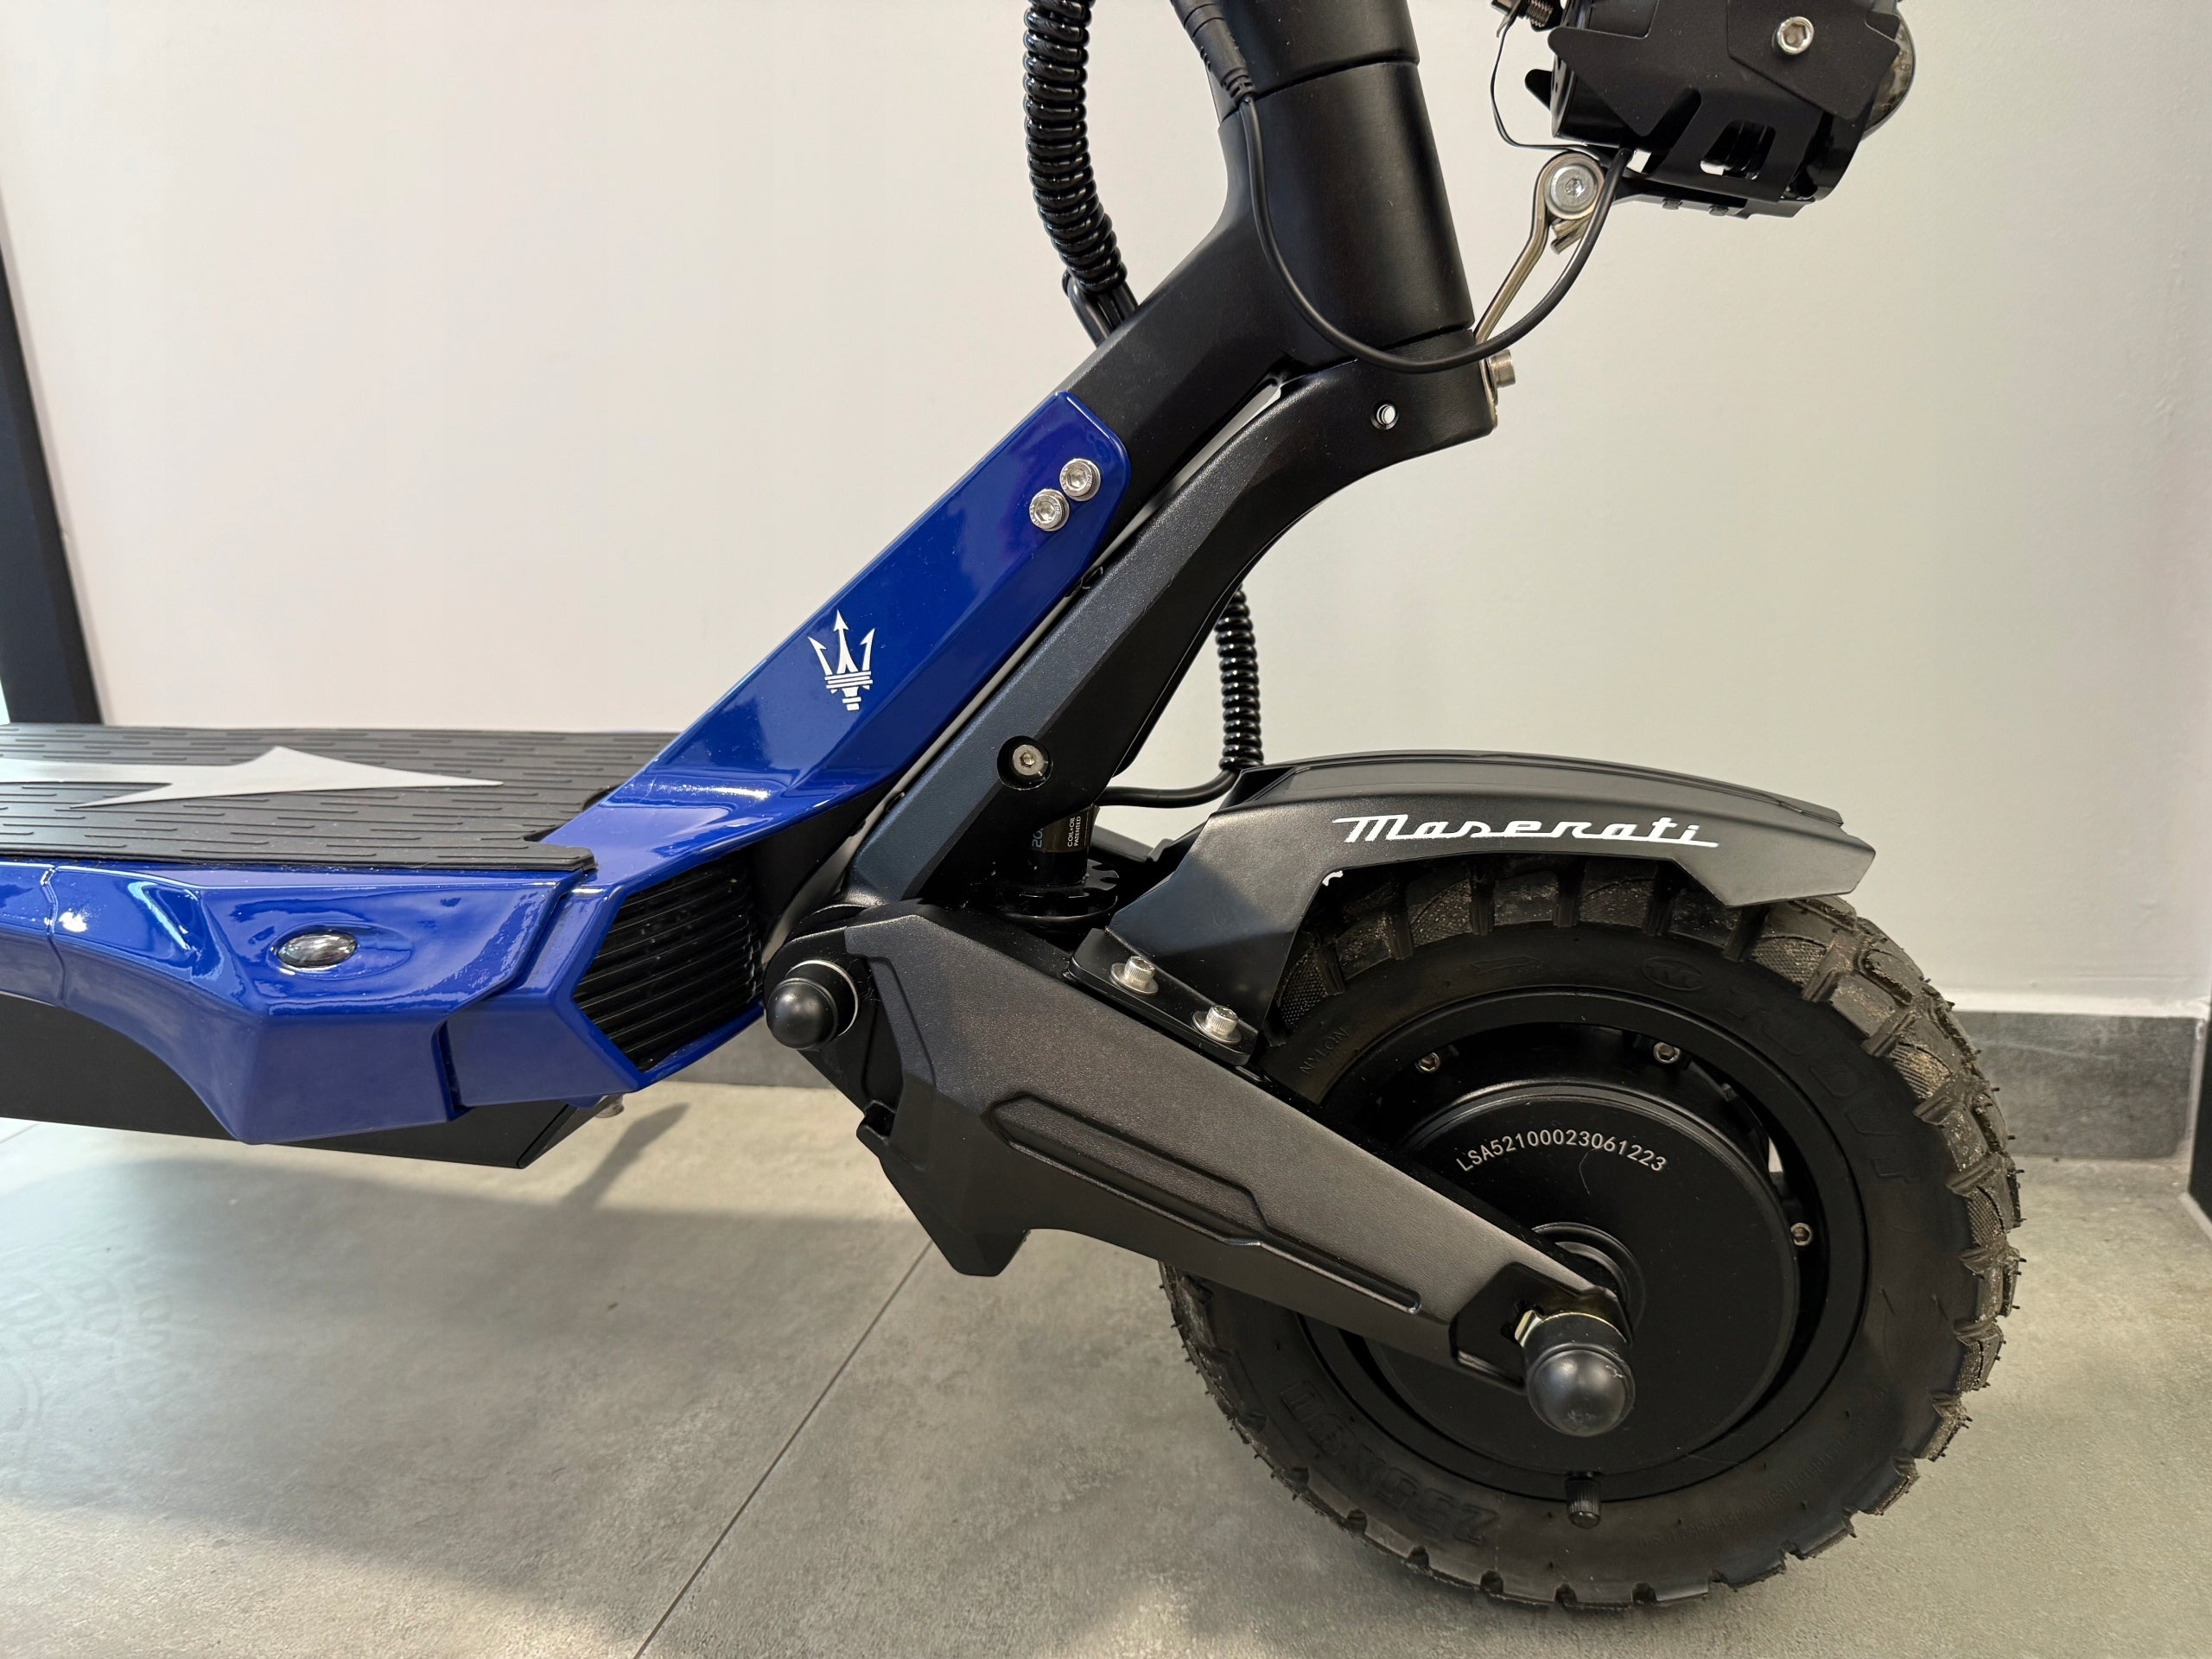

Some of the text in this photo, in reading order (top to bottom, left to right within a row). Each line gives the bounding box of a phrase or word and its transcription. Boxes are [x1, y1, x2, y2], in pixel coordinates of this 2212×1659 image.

[1067, 817, 1076, 848] COIL+OIL
[1332, 814, 1718, 848] Maserati
[1299, 1027, 1351, 1075] NYLON
[1456, 1128, 1668, 1172] LSA52100023061223
